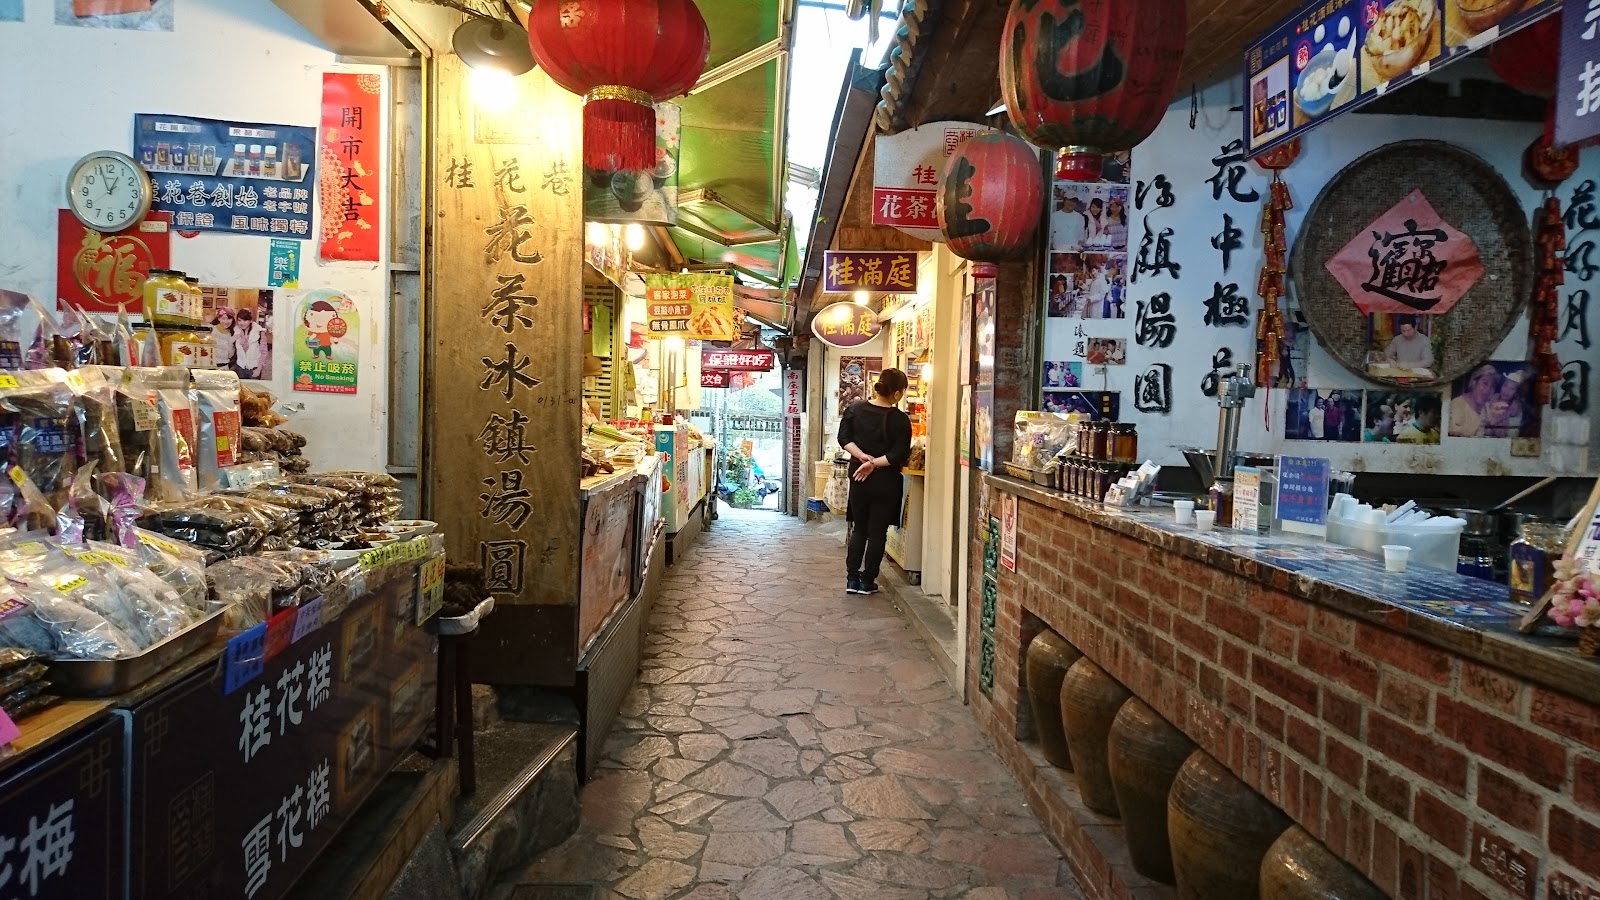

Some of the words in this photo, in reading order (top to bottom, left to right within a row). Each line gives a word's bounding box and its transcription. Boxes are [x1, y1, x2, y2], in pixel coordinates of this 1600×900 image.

[106, 164, 115, 173] 12
[340, 107, 363, 221] 開市大吉
[120, 168, 125, 177] 1
[444, 156, 574, 197] 桂花巷
[912, 164, 939, 186] 桂
[85, 175, 95, 185] 10
[128, 177, 135, 187] 2
[82, 187, 89, 197] 9
[131, 190, 139, 200] 3
[263, 186, 308, 200] 老品牌
[128, 201, 135, 211] 4
[263, 200, 308, 214] 老字號
[95, 209, 101, 218] 7
[107, 212, 114, 221] 6
[119, 210, 126, 219] 5
[168, 211, 214, 228] 保證
[231, 215, 308, 234] 風味獨特
[274, 256, 289, 271] 樂
[91, 243, 146, 298] 福
[828, 255, 914, 288] 桂滿庭
[653, 289, 687, 300] 客家泡菜
[652, 320, 686, 331] 無骨鳳爪
[821, 311, 874, 337] 桂滿庭
[707, 353, 771, 366] 保證好吃
[300, 361, 355, 374] 禁止吸菸
[474, 203, 544, 599] 花茶冰鎮湯圓
[239, 642, 331, 763] 桂花糕
[242, 757, 330, 900] 雪花糕
